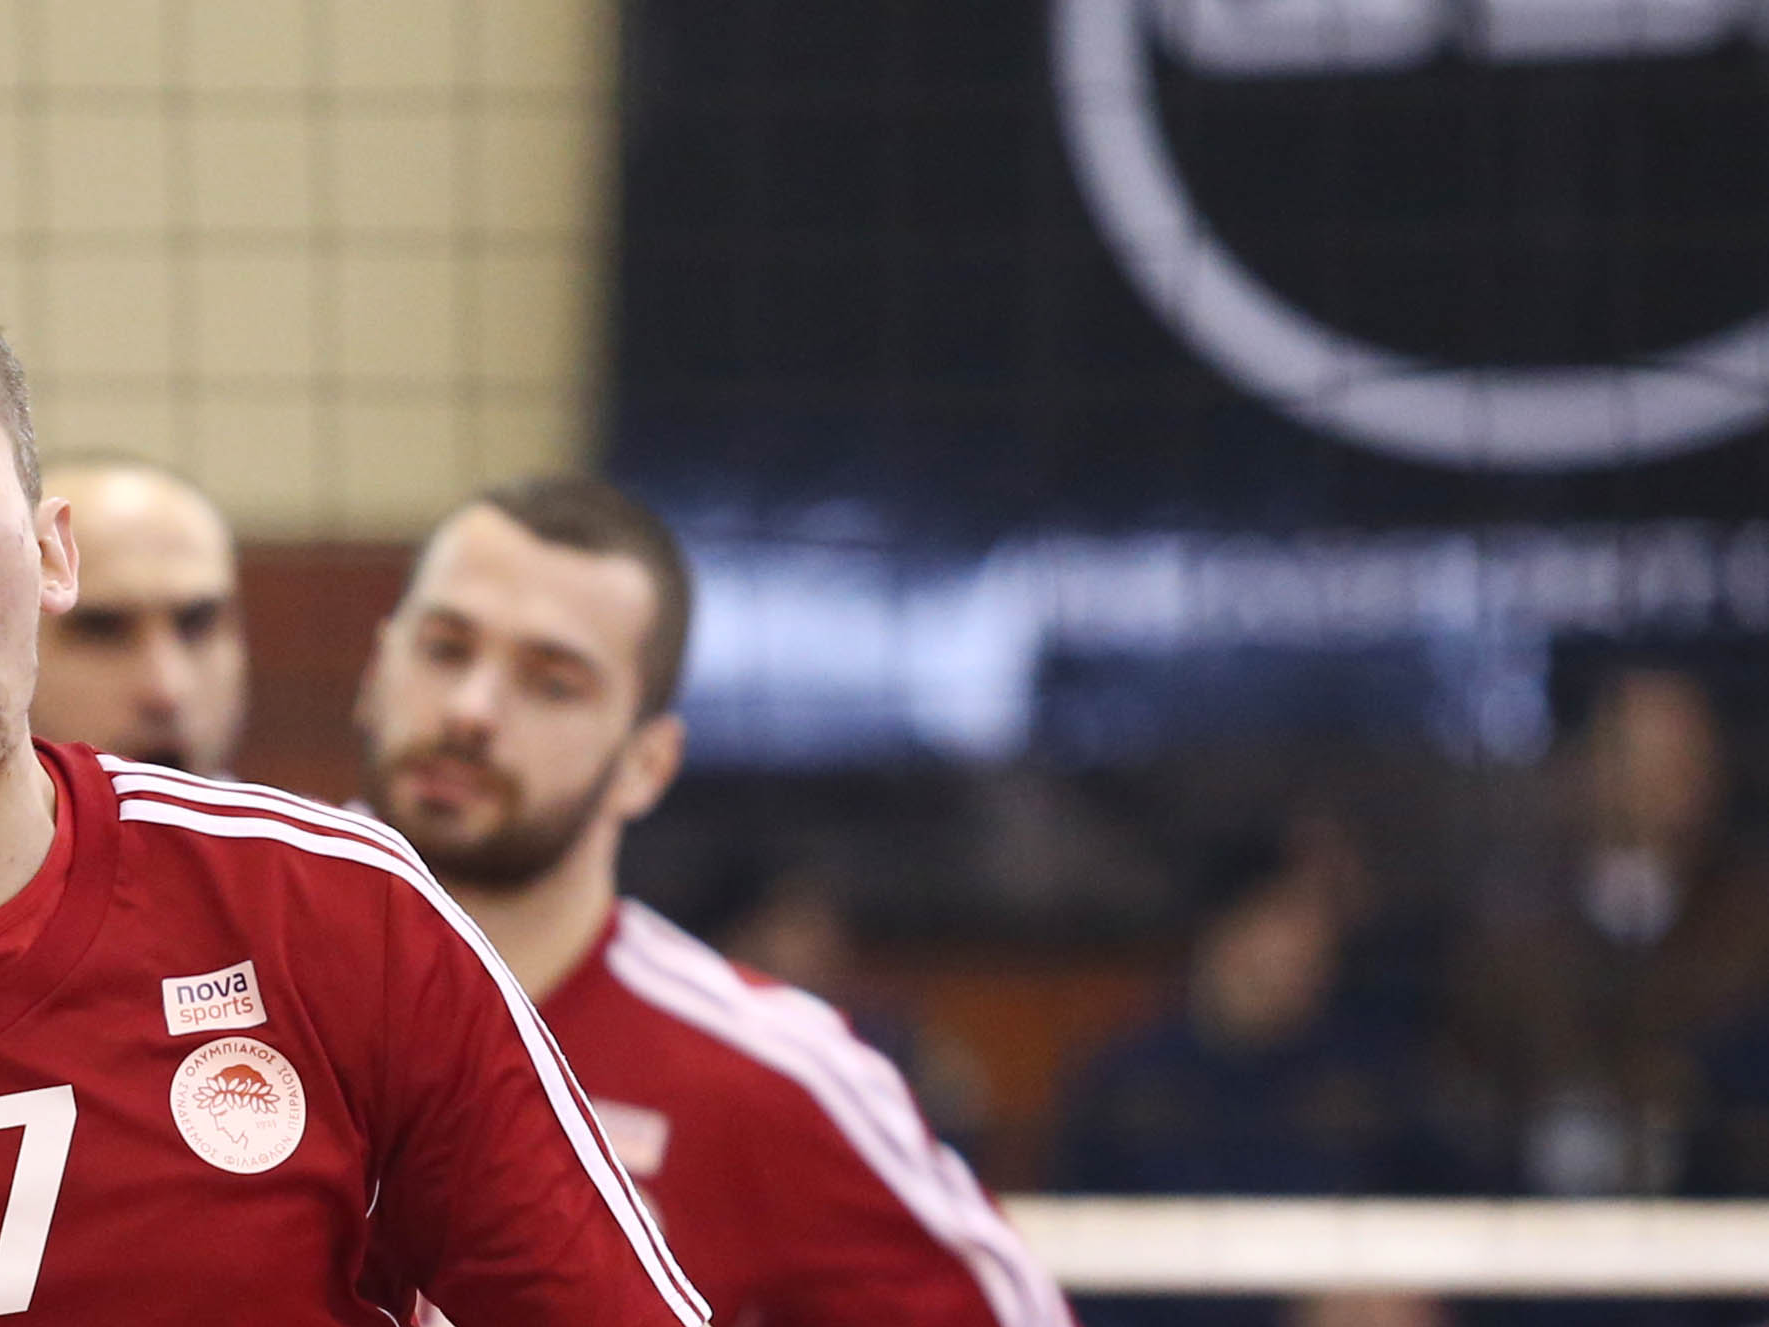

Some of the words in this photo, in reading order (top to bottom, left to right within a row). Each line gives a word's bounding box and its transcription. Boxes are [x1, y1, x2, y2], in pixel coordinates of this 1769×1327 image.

[177, 972, 248, 1005] nova
[179, 996, 254, 1025] sports
[185, 1042, 278, 1077] ΟΛΥΜΠΙΑΚΟΣ
